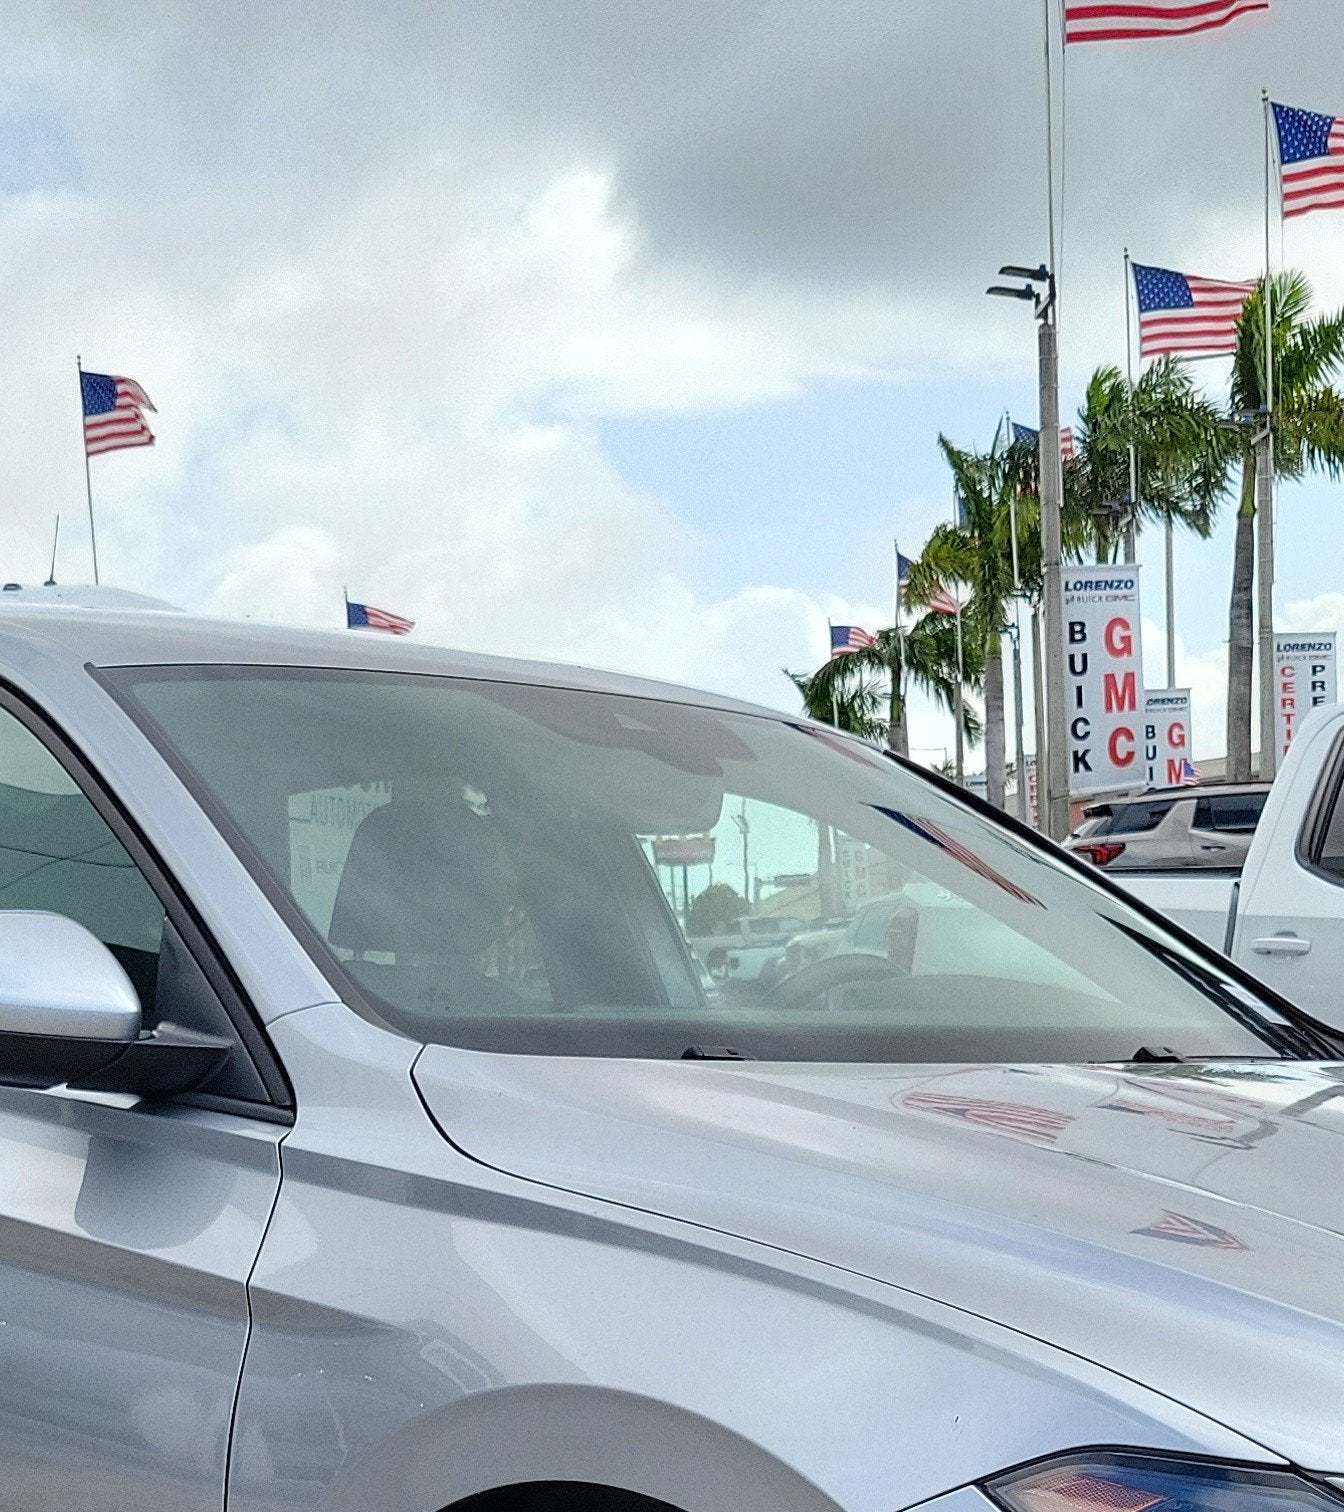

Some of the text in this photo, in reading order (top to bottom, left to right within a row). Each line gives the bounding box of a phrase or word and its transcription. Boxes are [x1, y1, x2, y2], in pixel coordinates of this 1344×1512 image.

[1064, 579, 1135, 592] LORENZO
[1076, 596, 1104, 604] BUICK
[1276, 642, 1332, 653] LORENZO
[1068, 621, 1092, 774] BUICK
[1104, 617, 1137, 768] GMC
[1145, 724, 1157, 782] BUI
